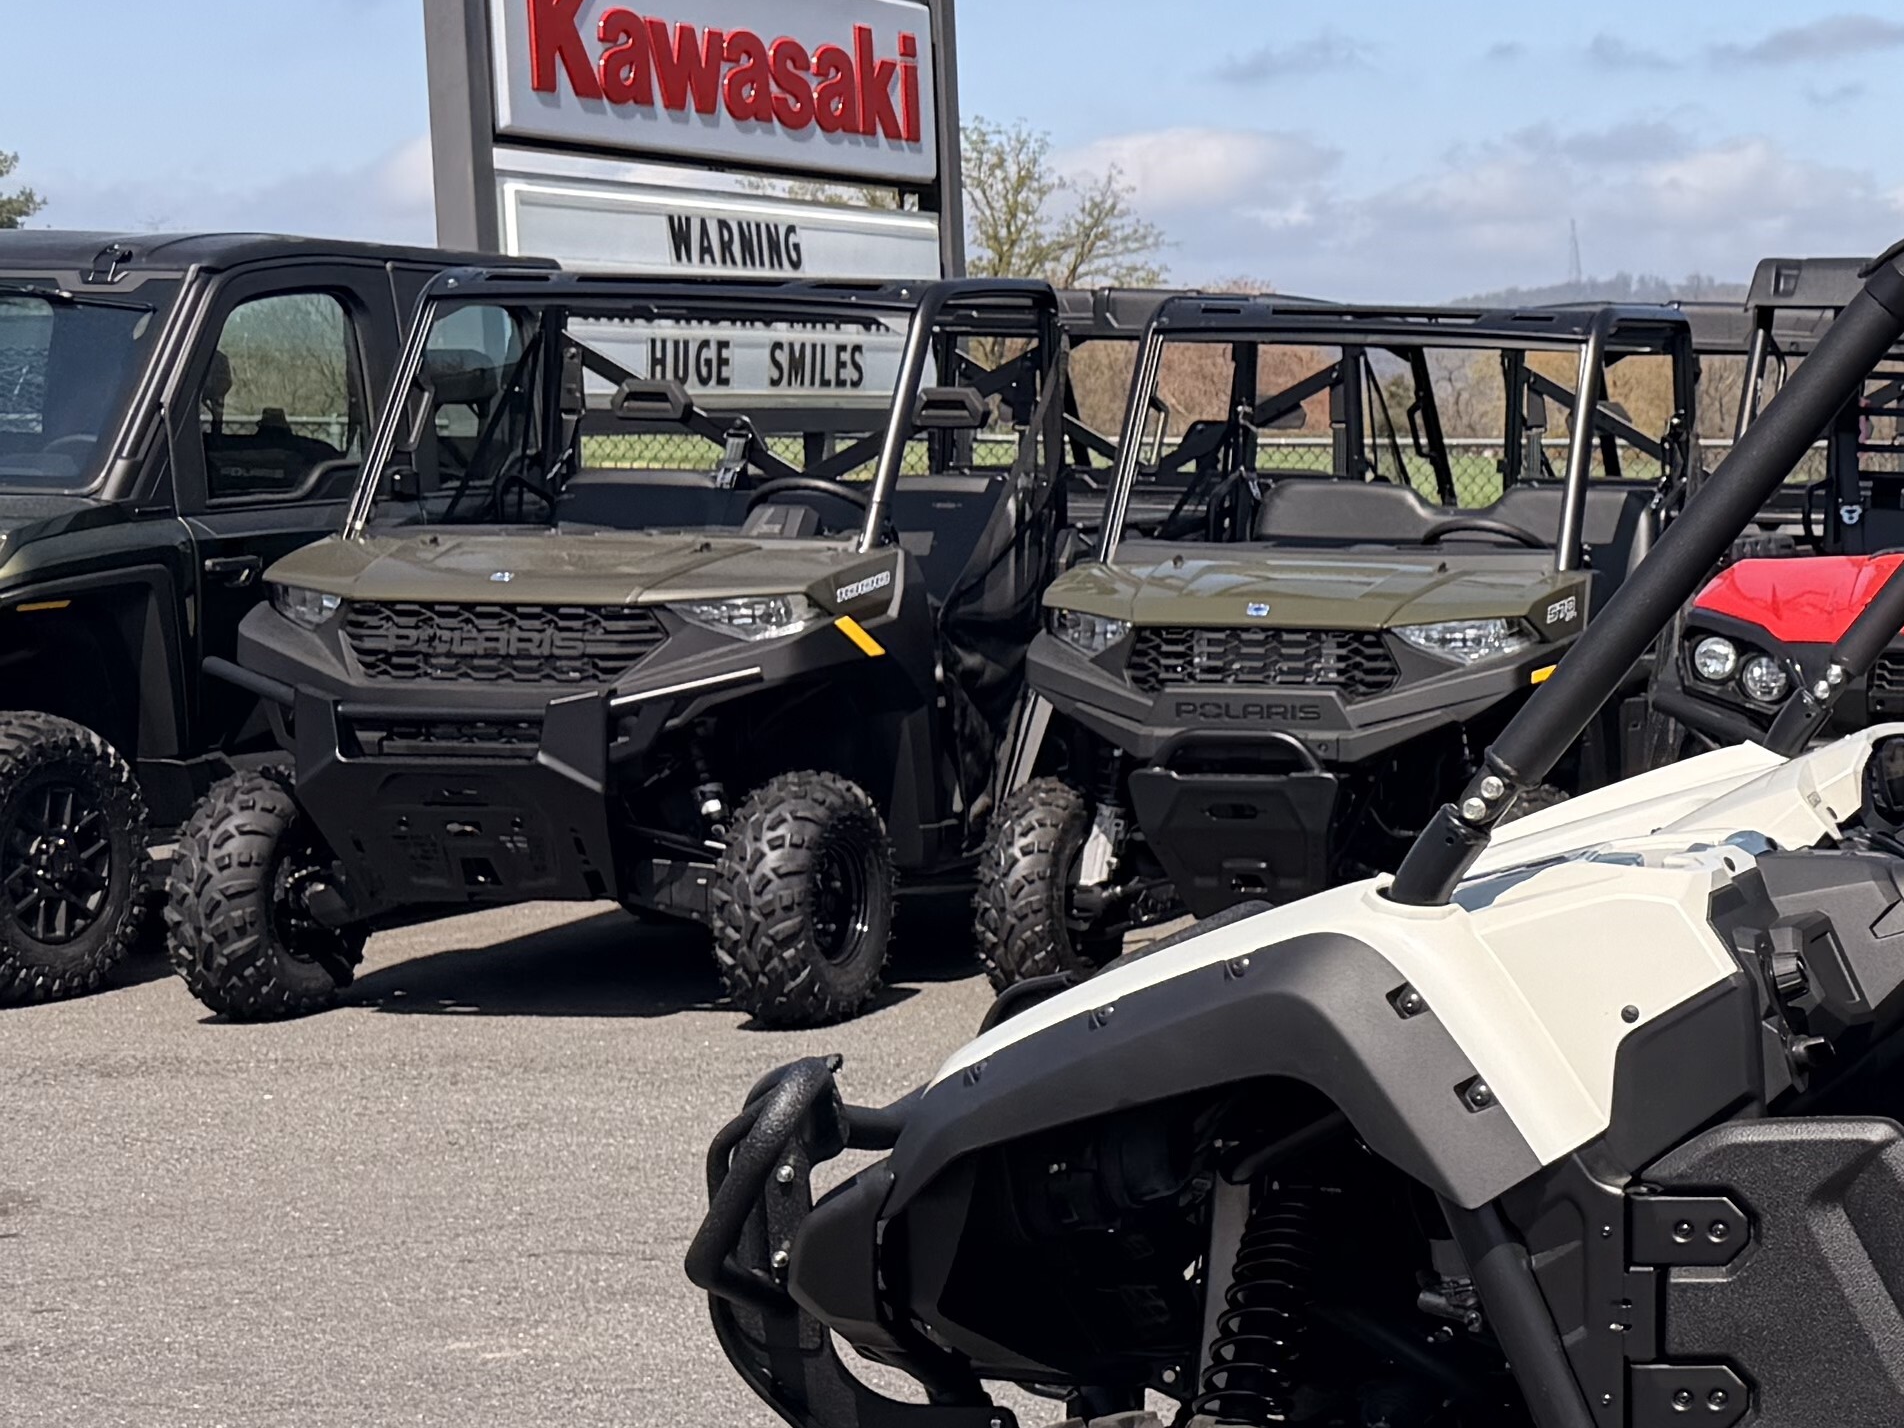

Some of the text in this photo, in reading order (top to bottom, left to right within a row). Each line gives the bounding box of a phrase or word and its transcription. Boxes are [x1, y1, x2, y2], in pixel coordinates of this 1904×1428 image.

[667, 215, 802, 270] WARNING
[650, 337, 864, 388] HUGE SMILES
[387, 628, 586, 656] POLARIS
[1175, 701, 1321, 721] POLARIS
